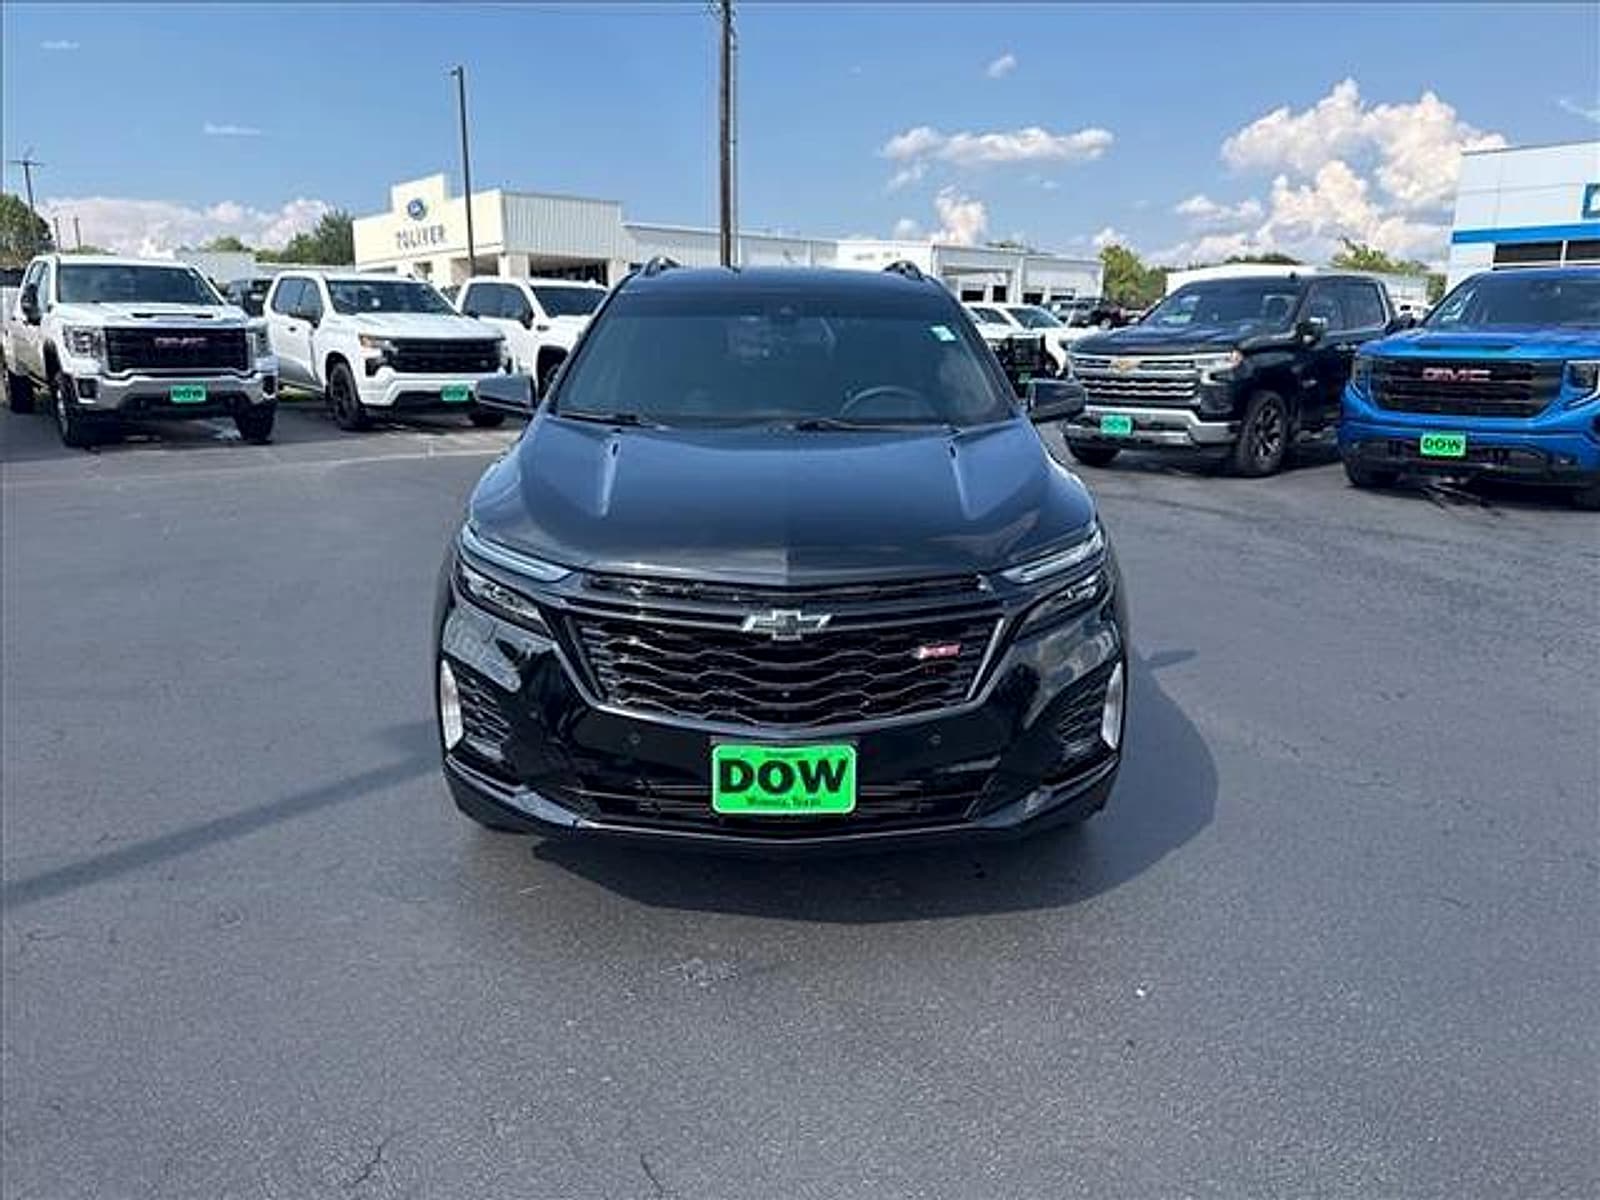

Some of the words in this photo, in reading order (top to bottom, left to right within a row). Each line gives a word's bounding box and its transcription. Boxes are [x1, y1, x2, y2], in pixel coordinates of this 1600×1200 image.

[1422, 367, 1491, 381] GMC
[1423, 438, 1461, 451] DOW
[719, 759, 848, 794] DOW
